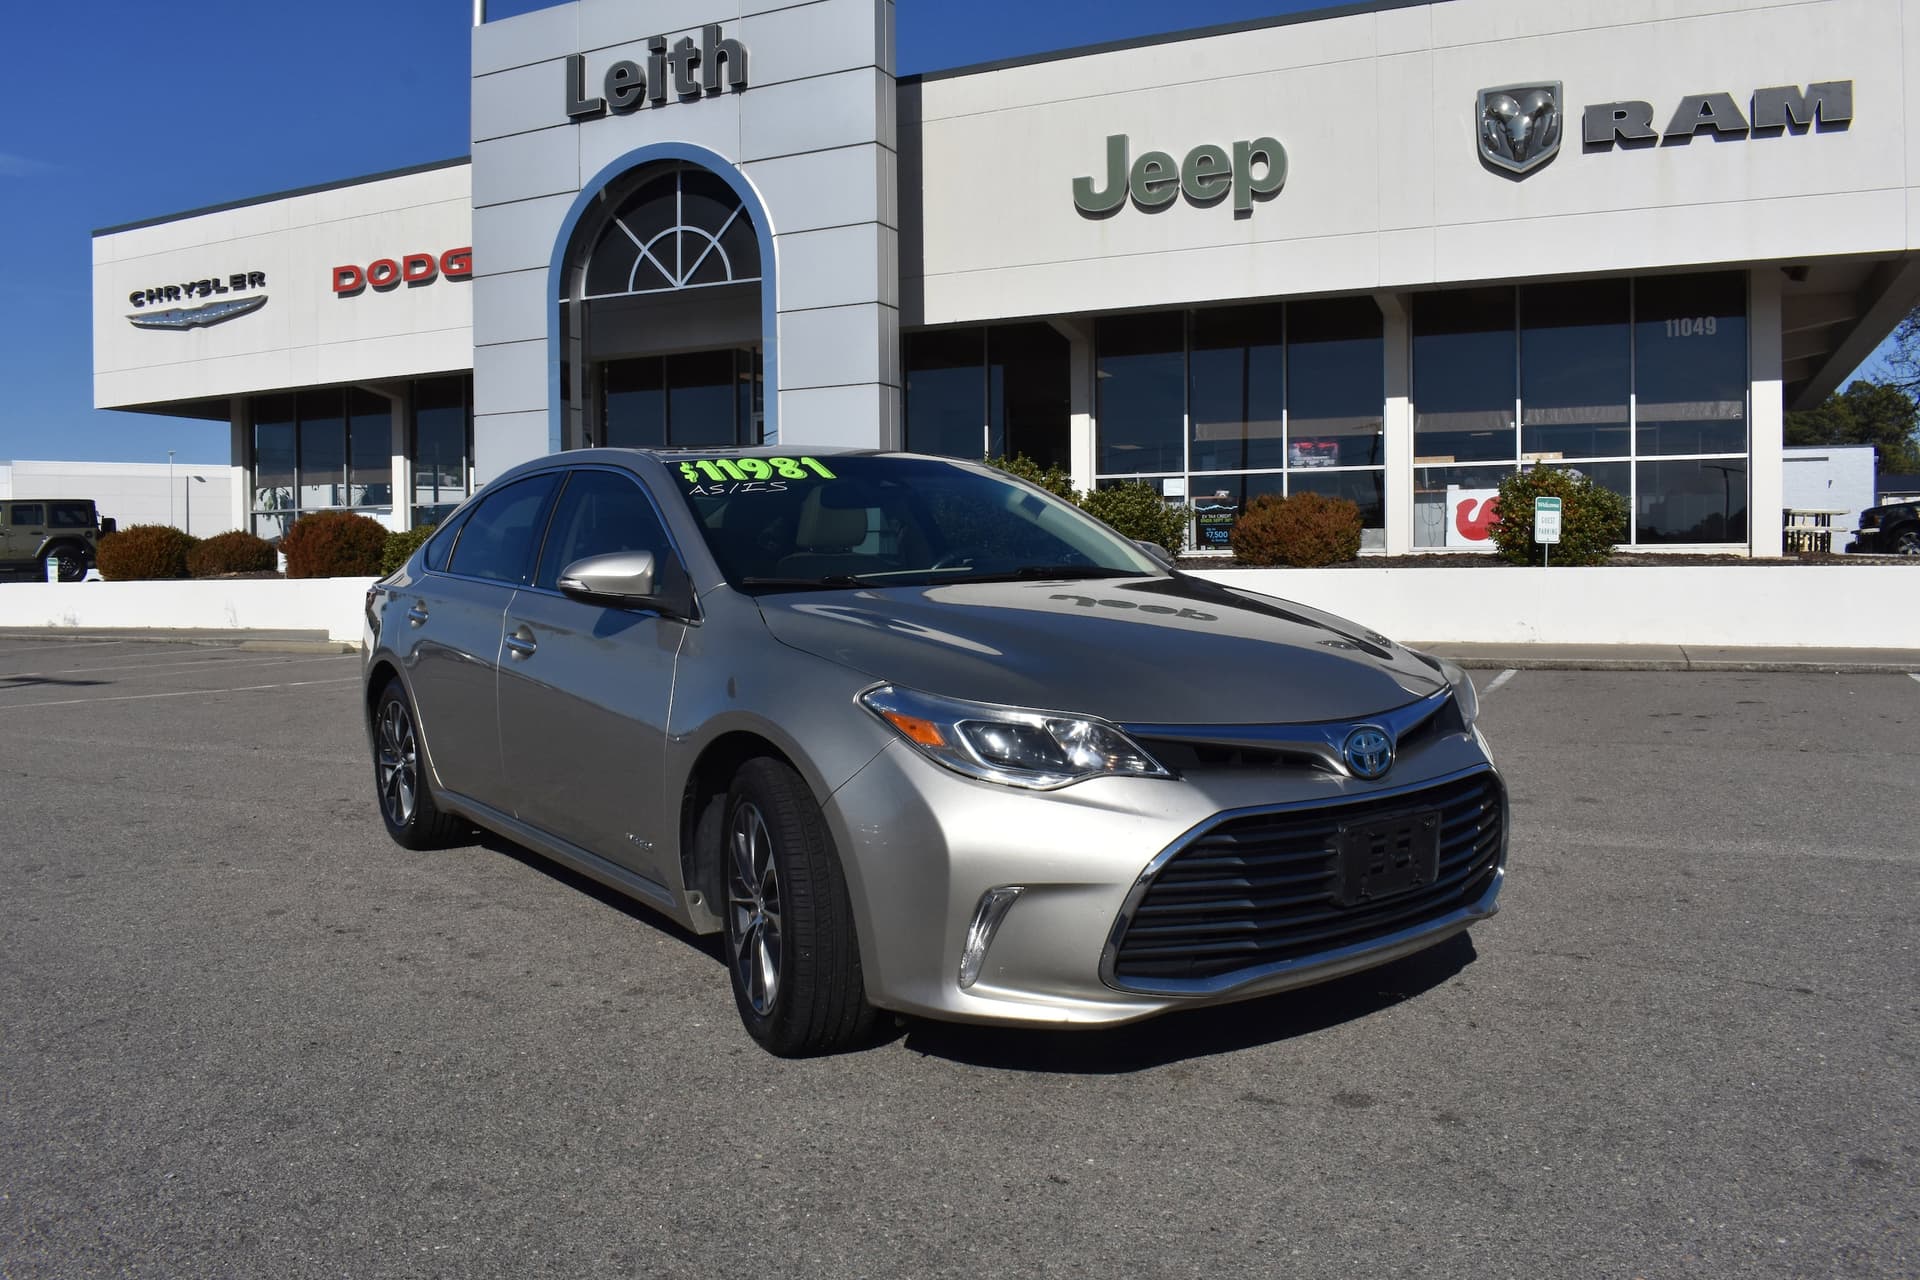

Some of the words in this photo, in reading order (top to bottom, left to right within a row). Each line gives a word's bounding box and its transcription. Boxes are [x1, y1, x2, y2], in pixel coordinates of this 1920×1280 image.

[566, 23, 748, 120] Leith
[1582, 80, 1853, 154] RAM
[1072, 134, 1288, 220] Jeep
[129, 271, 267, 308] CHRYSLER
[1665, 316, 1717, 338] 11049
[679, 457, 838, 483] $11981
